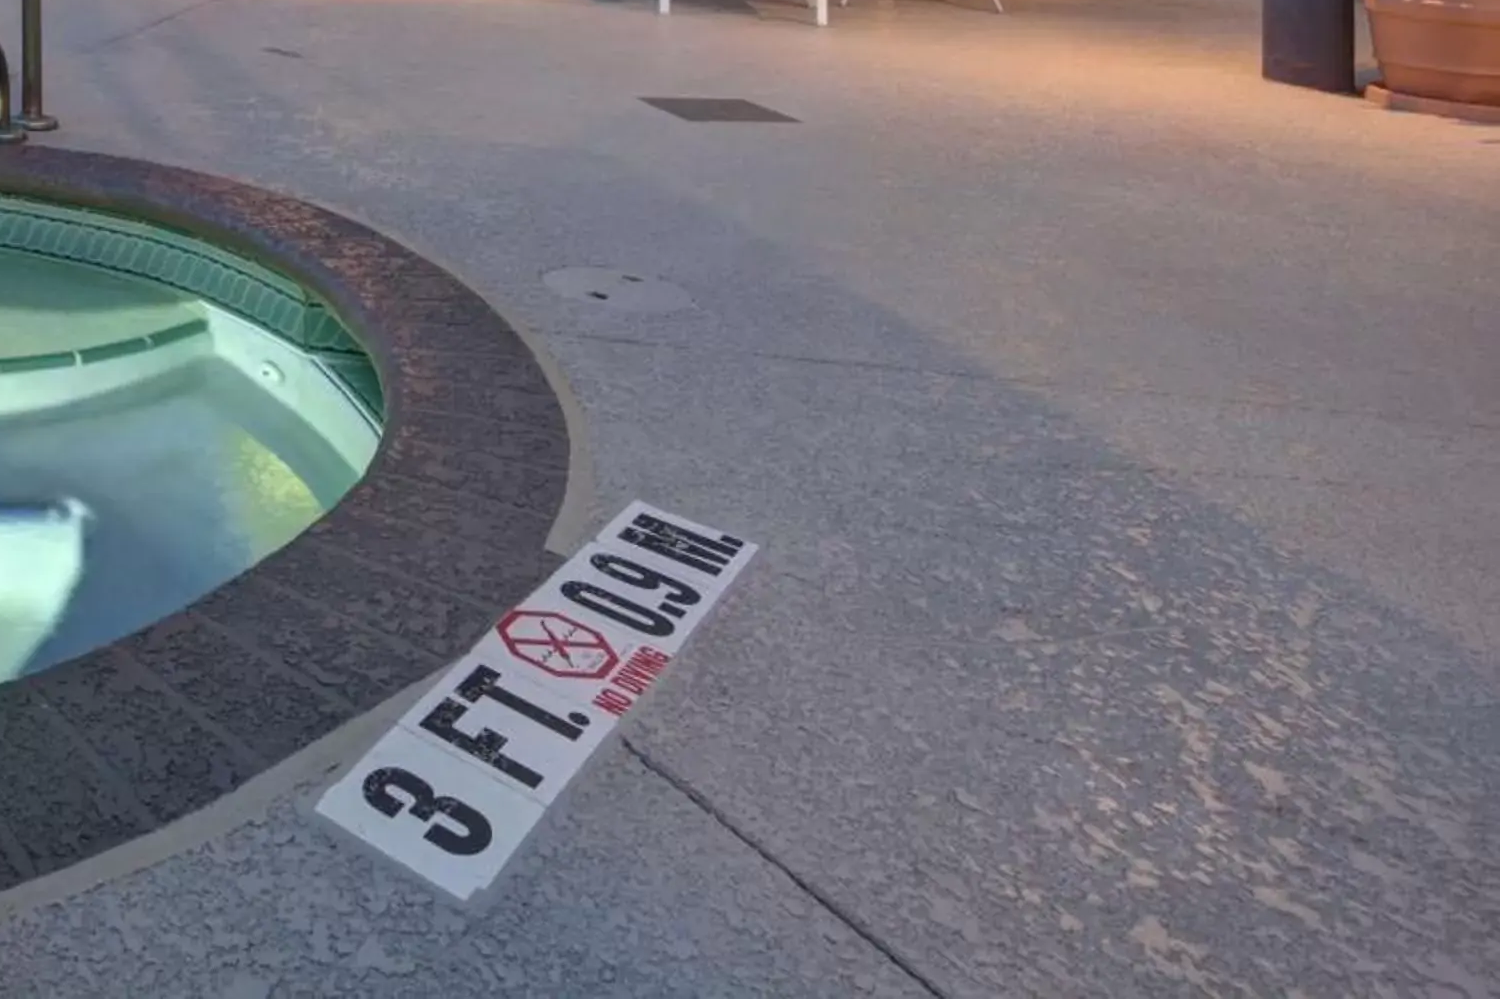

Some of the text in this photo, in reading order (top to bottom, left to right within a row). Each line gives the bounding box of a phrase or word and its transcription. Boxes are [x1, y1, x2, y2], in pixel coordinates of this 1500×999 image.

[362, 512, 744, 856] 3 FT. 0.9 M.
[591, 645, 670, 716] NO DIVING
